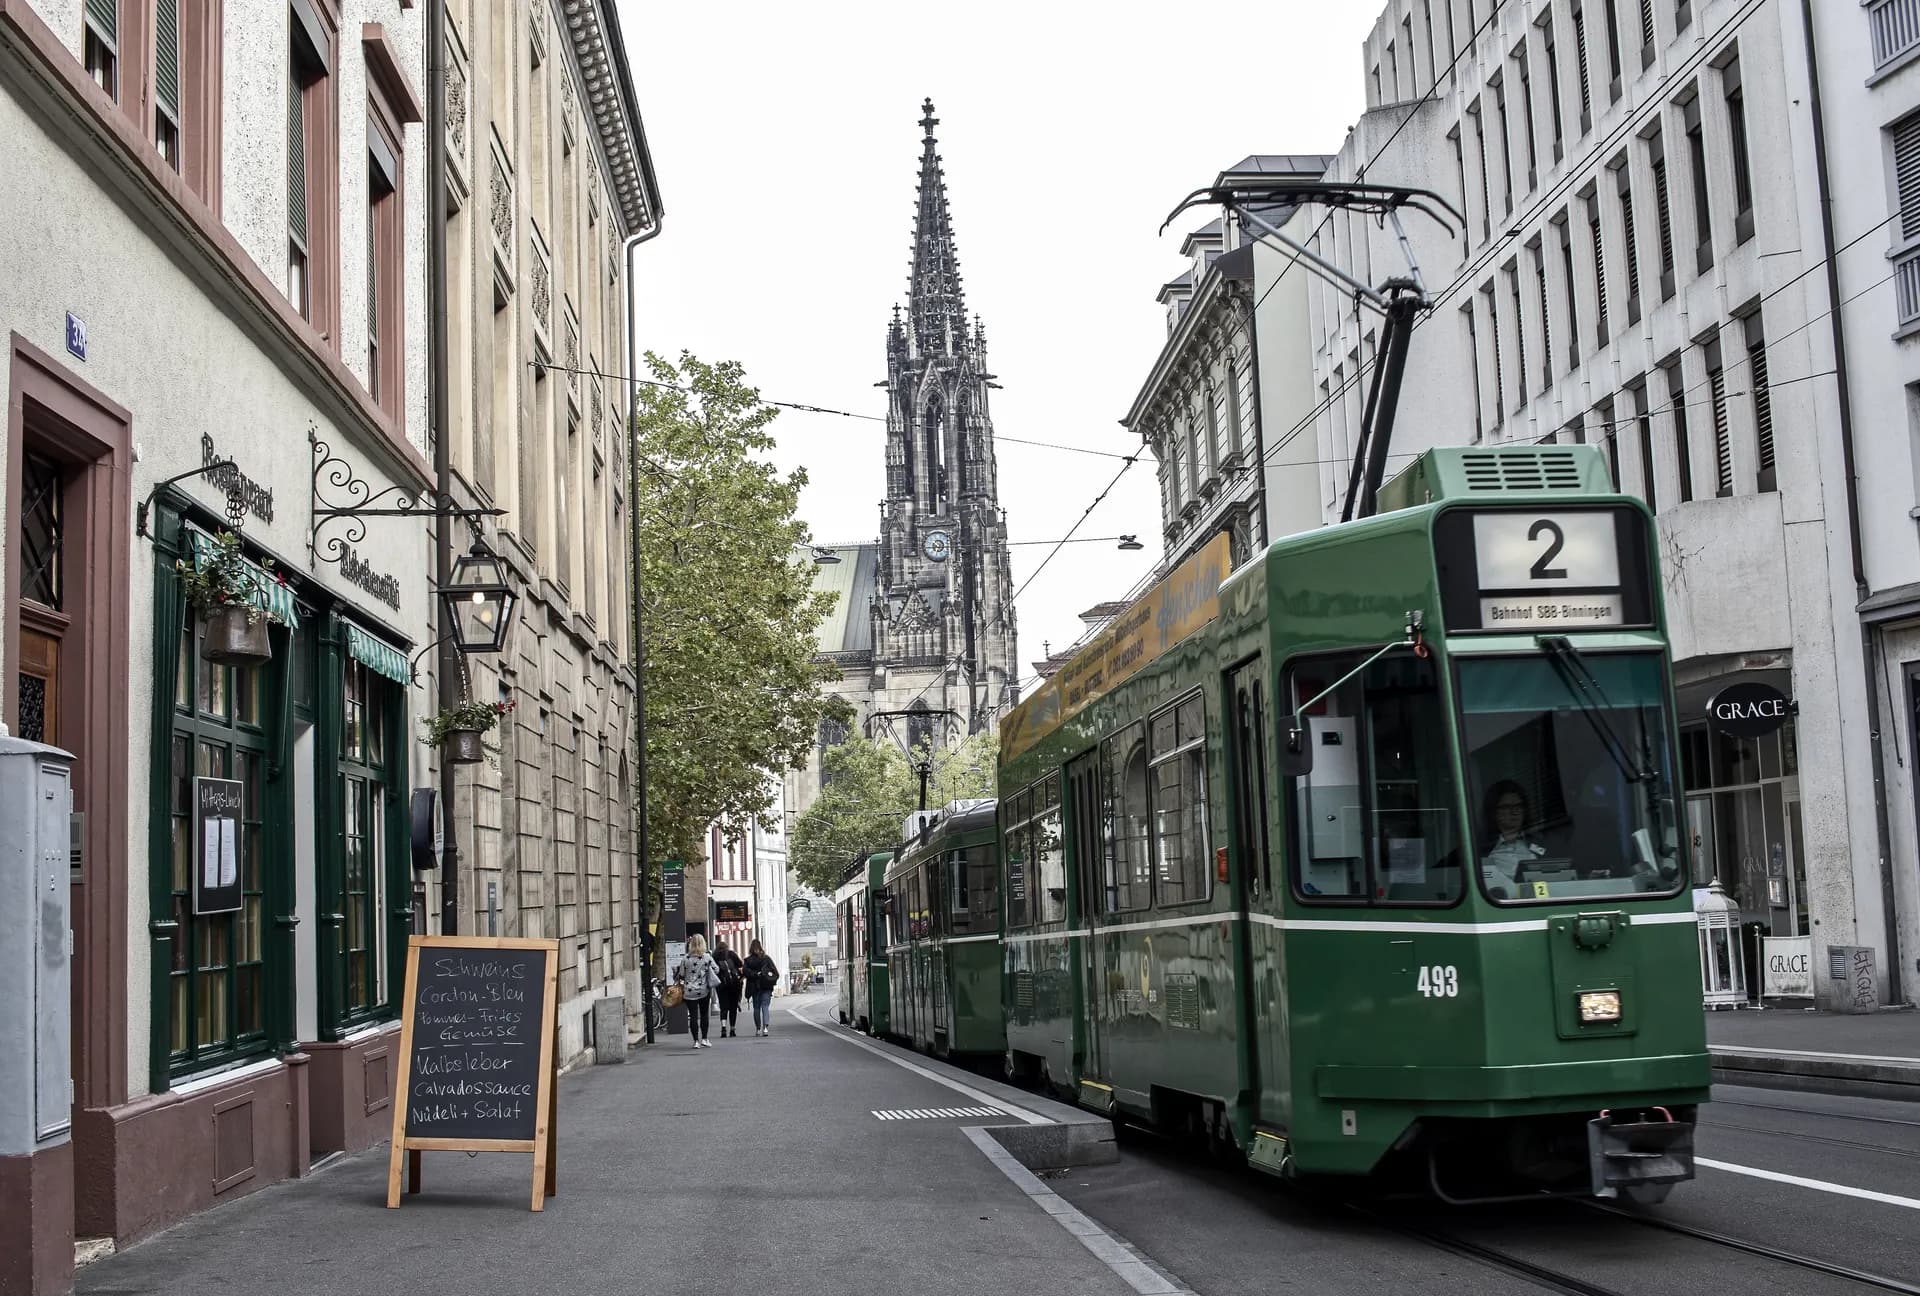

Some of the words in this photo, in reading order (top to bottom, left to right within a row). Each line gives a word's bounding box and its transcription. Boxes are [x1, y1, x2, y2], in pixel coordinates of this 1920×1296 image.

[72, 322, 85, 351] 34
[1527, 518, 1568, 580] 2
[1491, 605, 1533, 620] Bahnhof
[1537, 603, 1612, 619] SBB-Binningen
[1716, 699, 1785, 720] GRACE
[434, 958, 527, 979] Schweins
[1769, 954, 1808, 973] GRACE
[1416, 964, 1459, 998] 493
[414, 1079, 532, 1097] Calvadossauce
[473, 1100, 521, 1119] Salat
